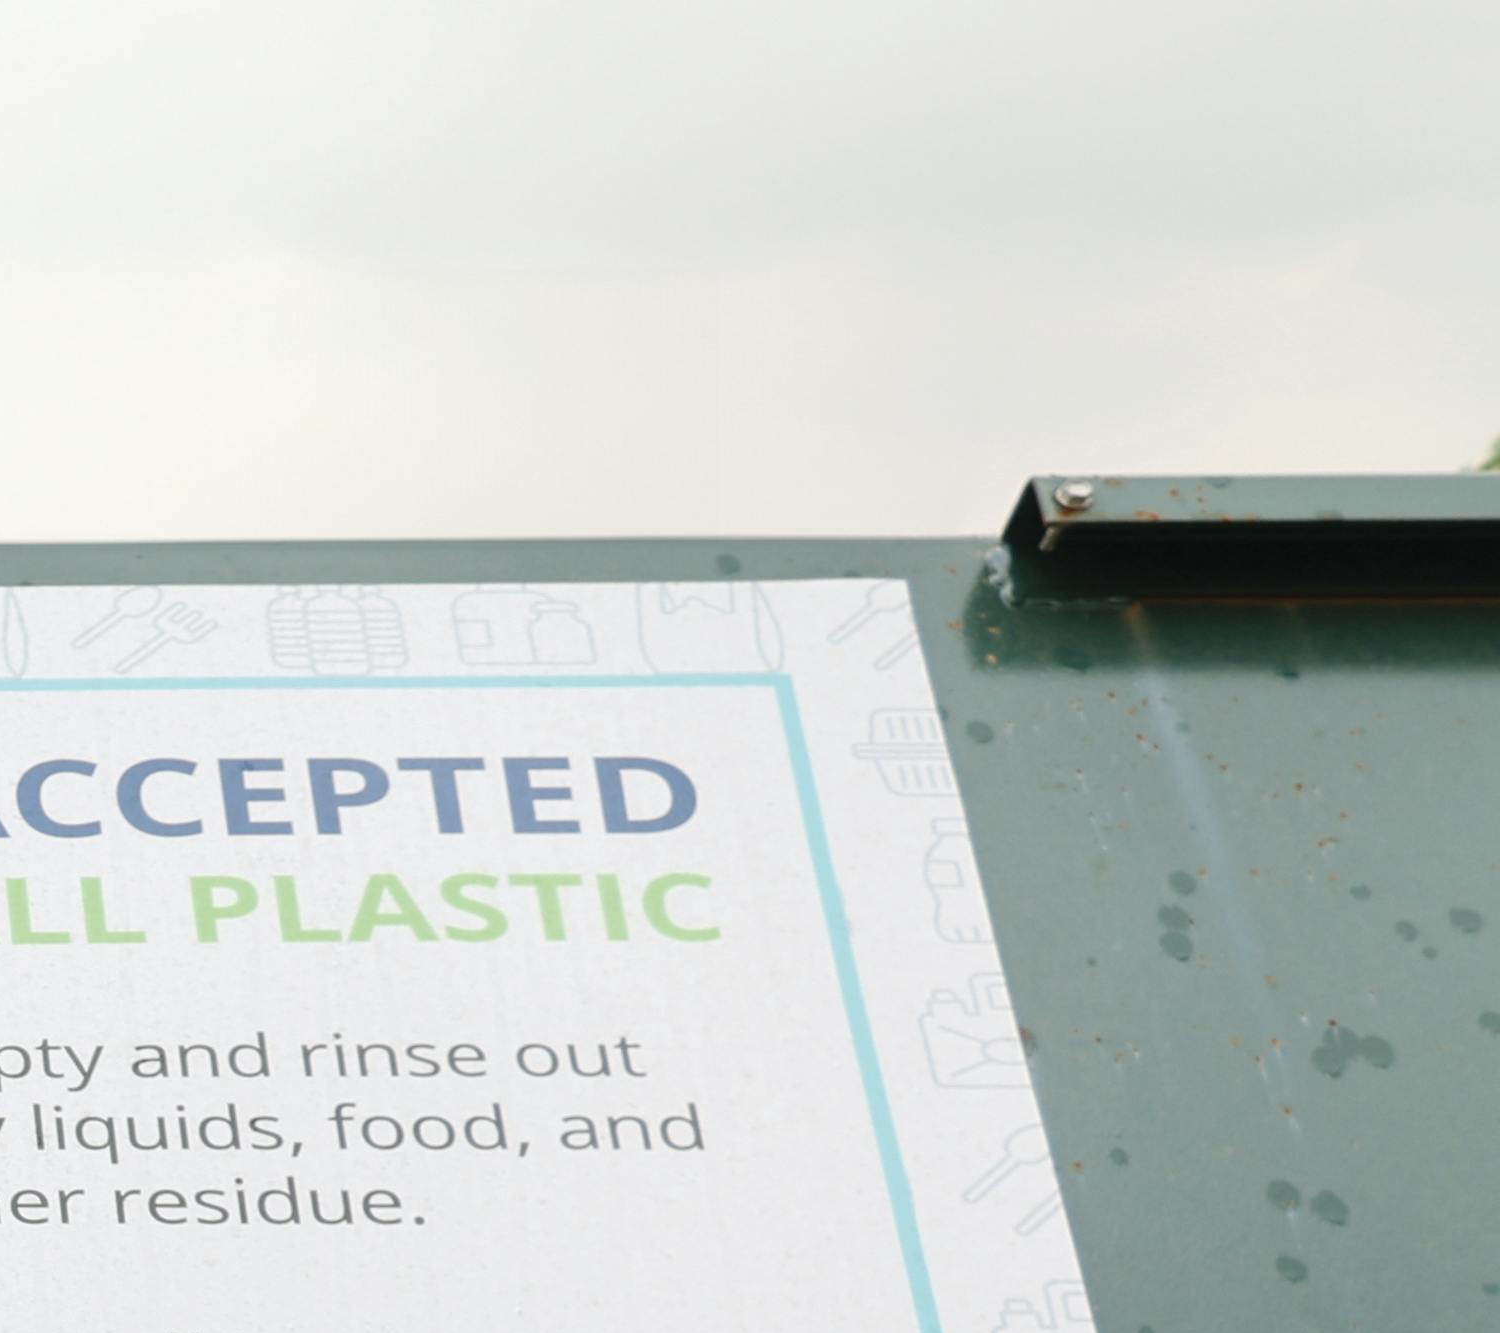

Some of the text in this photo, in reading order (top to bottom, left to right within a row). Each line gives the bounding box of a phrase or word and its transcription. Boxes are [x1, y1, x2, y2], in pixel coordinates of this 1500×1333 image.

[190, 873, 721, 943] PLASTIC
[129, 1031, 273, 1079] and
[298, 1032, 488, 1079] rinse
[515, 1036, 646, 1078] out
[31, 1102, 308, 1166] liquids,
[328, 1102, 531, 1158] food,
[557, 1102, 704, 1152] and
[112, 1175, 426, 1227] residue.
